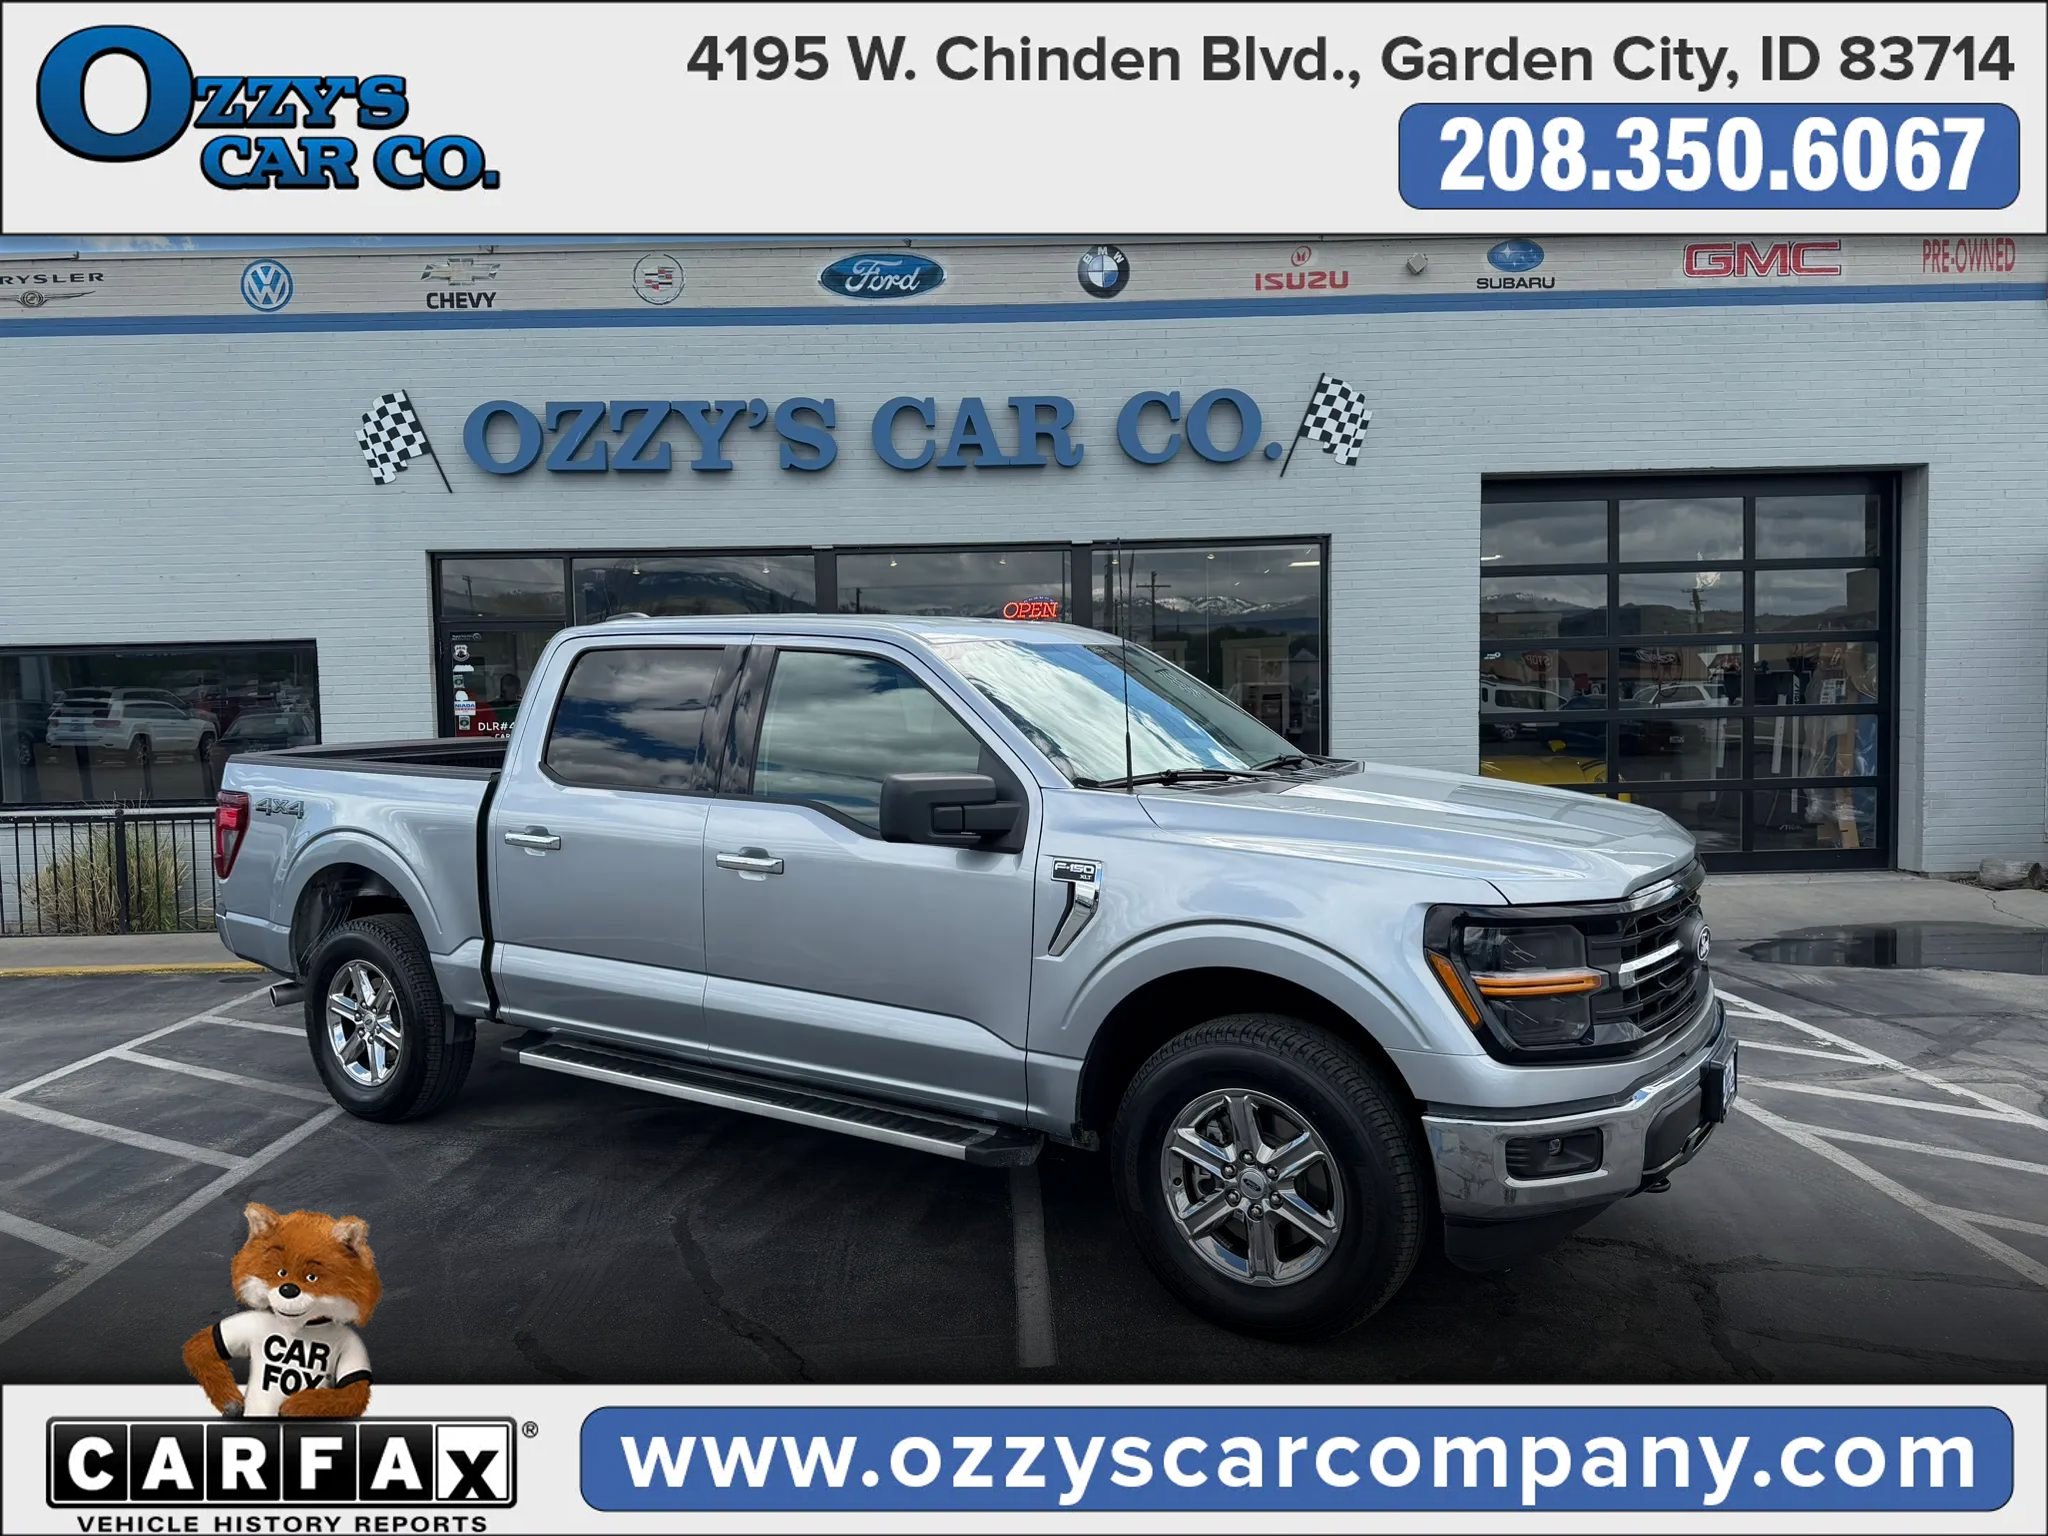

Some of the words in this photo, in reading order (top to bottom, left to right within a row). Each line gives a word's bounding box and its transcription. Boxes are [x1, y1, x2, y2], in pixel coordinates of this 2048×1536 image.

[1083, 246, 1125, 265] BMW
[1682, 239, 1842, 278] GMC
[1922, 238, 2016, 274] PRE-OWNED
[844, 259, 921, 292] Ford
[1254, 271, 1350, 292] ISUZU
[1476, 276, 1556, 290] SUBARU
[426, 291, 497, 310] CHEVY
[463, 397, 838, 474] OZZY'S
[871, 395, 1085, 470] CAR
[1116, 388, 1284, 464] CO.
[1003, 602, 1058, 619] OPEN
[1055, 862, 1095, 874] F-150
